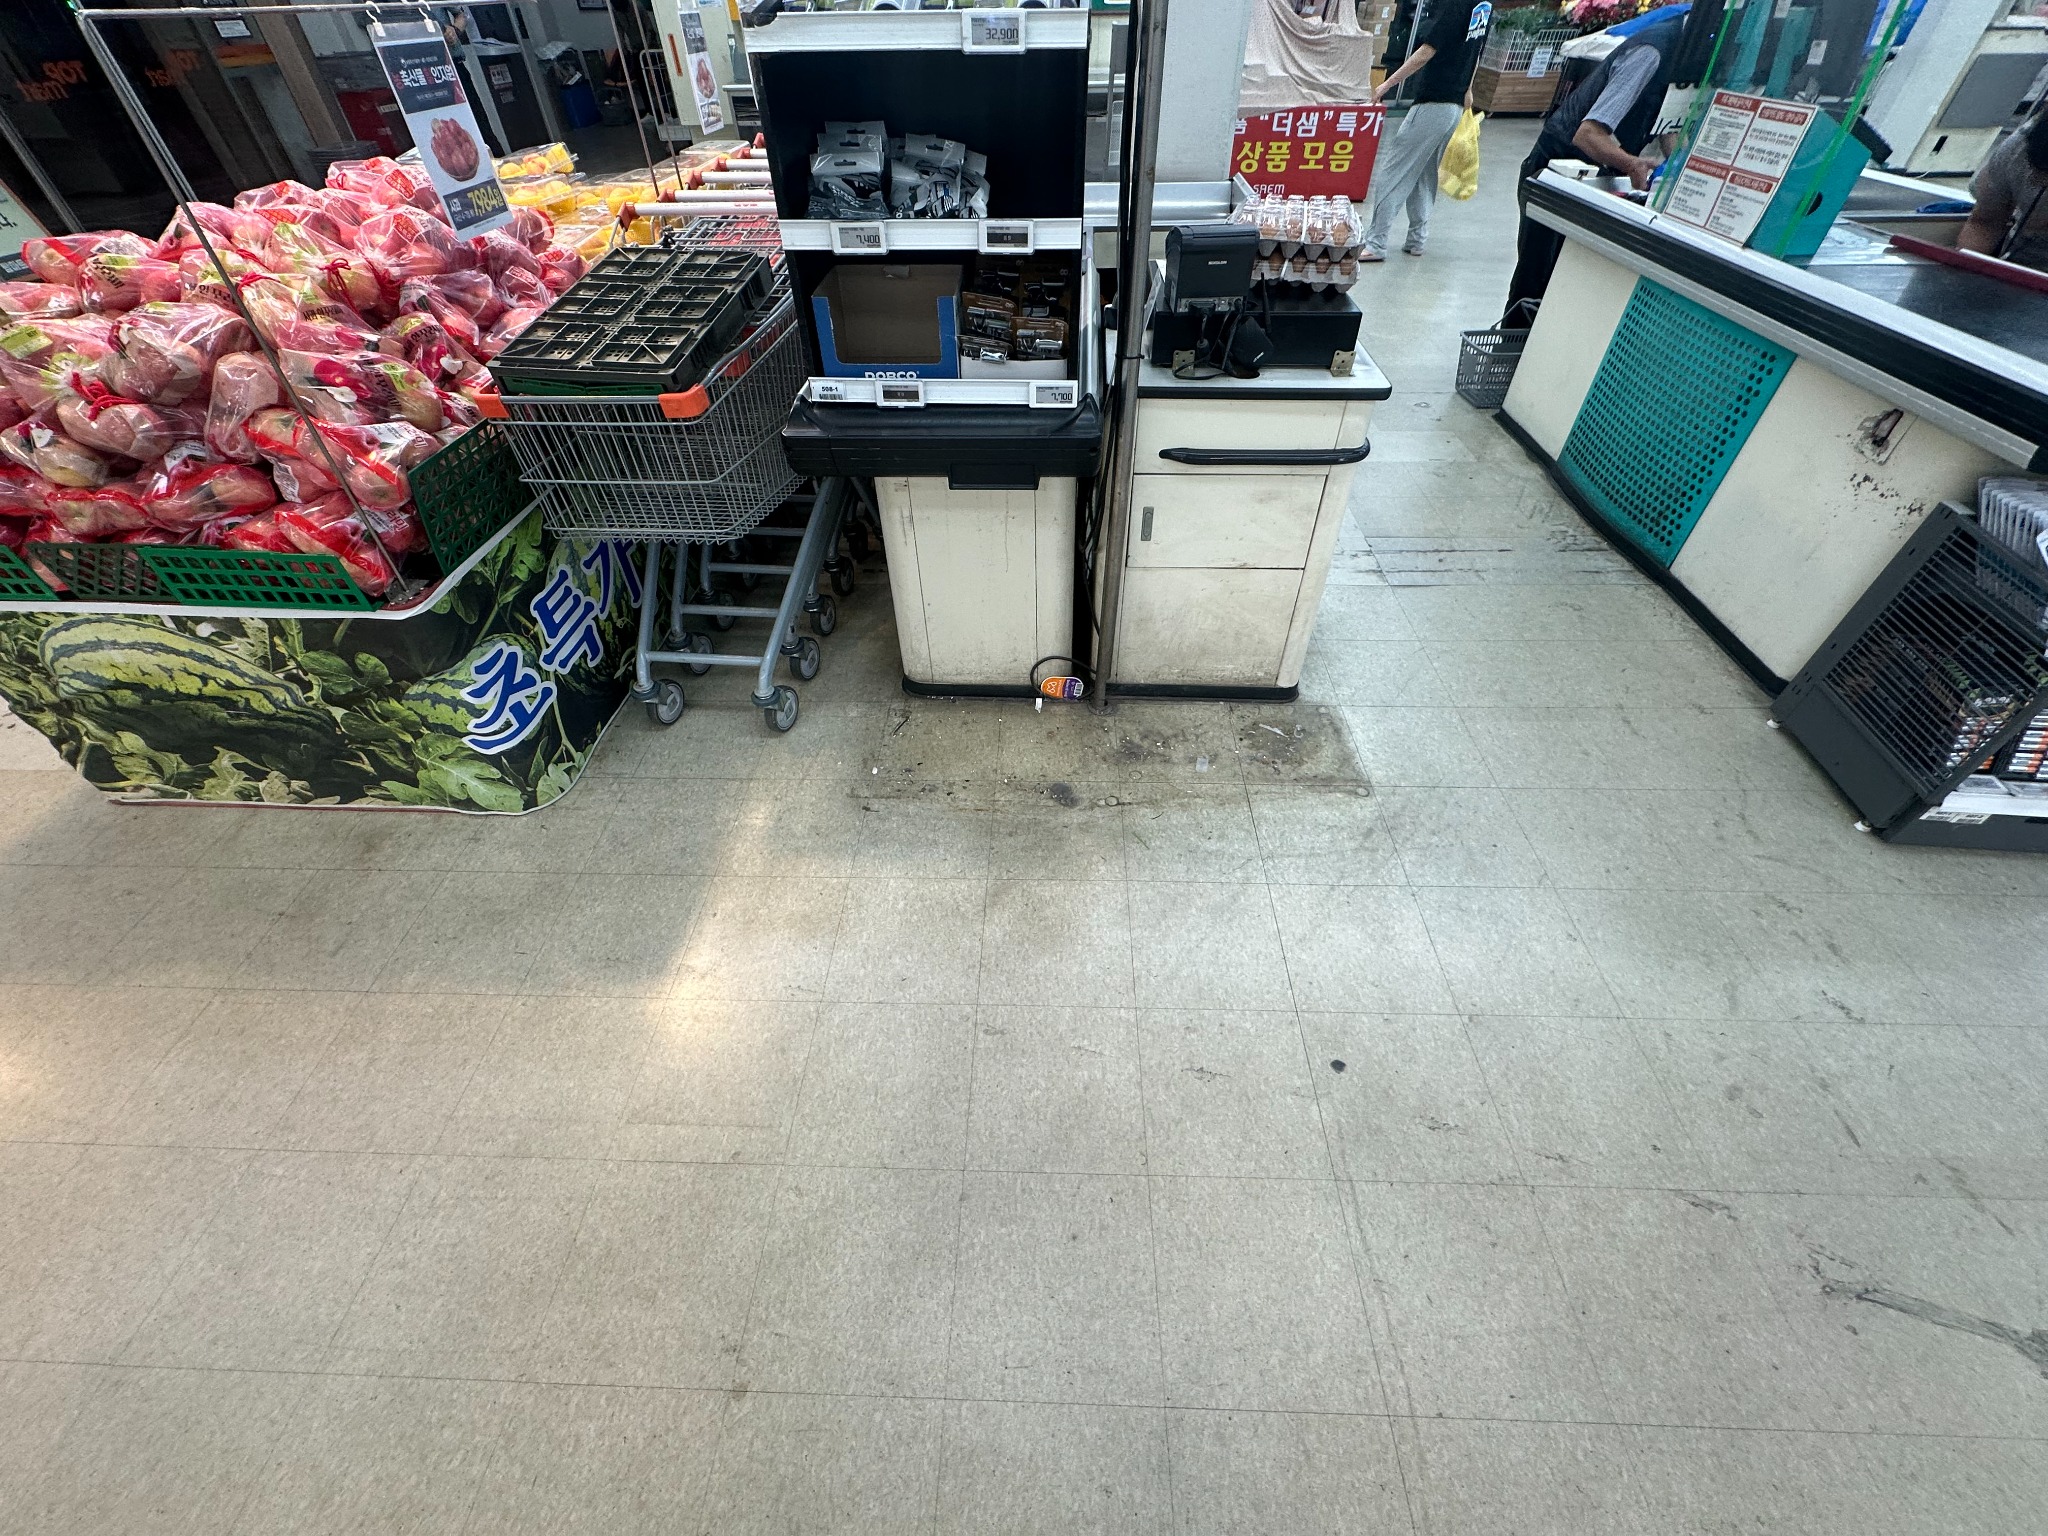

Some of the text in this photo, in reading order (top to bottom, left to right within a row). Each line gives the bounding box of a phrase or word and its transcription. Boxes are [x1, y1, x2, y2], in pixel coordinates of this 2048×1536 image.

[985, 28, 1019, 41] 32,900
[1237, 140, 1354, 173] 상품 모음
[1252, 184, 1285, 195] SAEM
[856, 234, 880, 245] 7,400
[1051, 392, 1073, 402] 7,700
[461, 540, 645, 755] 초특가
